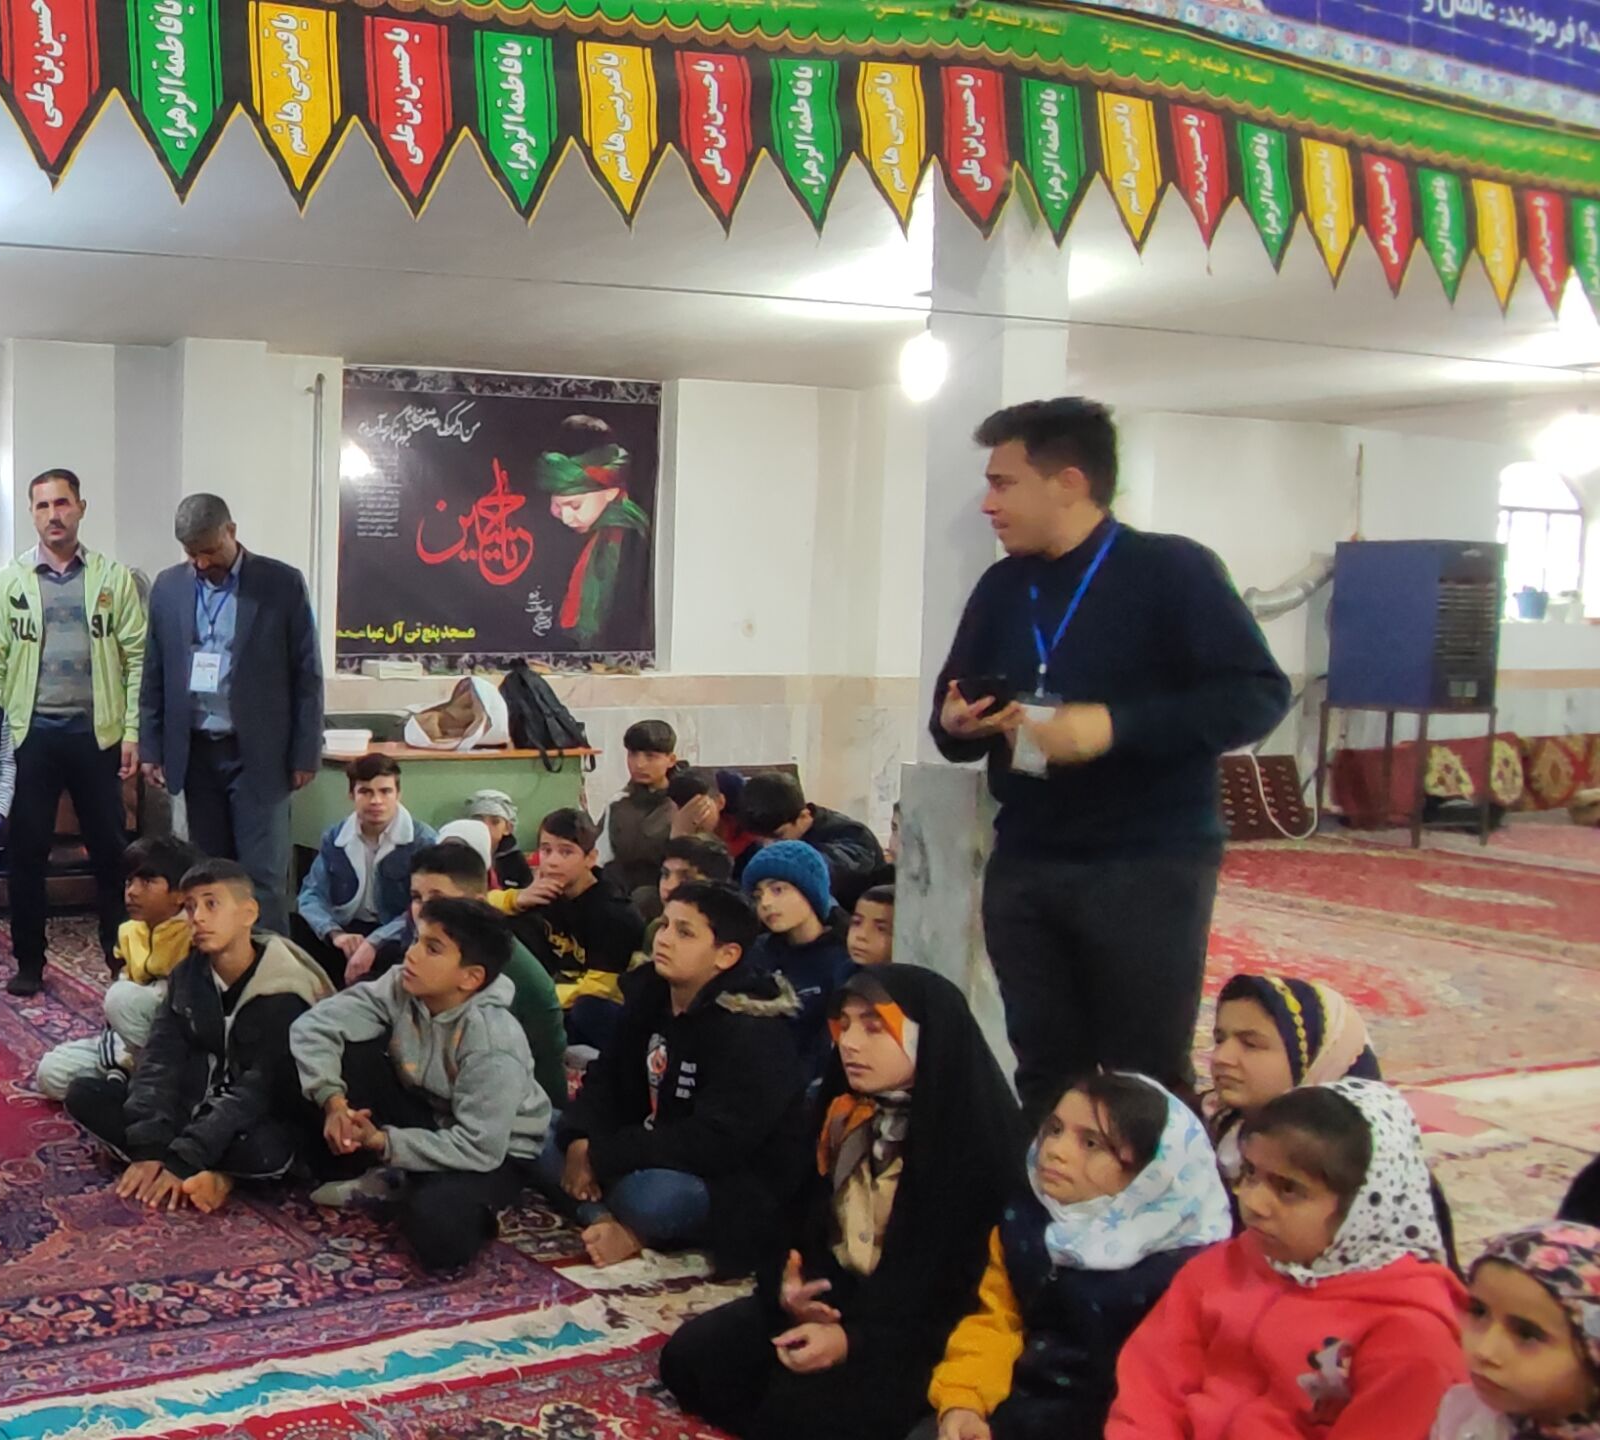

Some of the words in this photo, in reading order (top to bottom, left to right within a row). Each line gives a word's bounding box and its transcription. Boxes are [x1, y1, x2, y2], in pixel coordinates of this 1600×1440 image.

[270, 13, 309, 31] یا
[383, 27, 421, 44] یا
[263, 30, 310, 70] قمر
[497, 41, 533, 57] یا
[595, 52, 628, 66] یا
[33, 54, 67, 85] بن
[392, 43, 424, 100] حسین
[691, 59, 725, 73] یا
[792, 66, 823, 79] یا
[955, 73, 983, 87] یا
[25, 82, 64, 128] علی
[394, 98, 423, 125] بن
[702, 72, 728, 126] حسین
[962, 87, 986, 136] حسین
[272, 101, 311, 157] هاشم
[703, 125, 727, 149] بن
[389, 123, 424, 165] علی
[600, 131, 636, 183] هاشم
[699, 148, 732, 185] علی
[957, 158, 992, 192] علی
[366, 623, 385, 643] عبا
[384, 619, 405, 644] آل
[403, 621, 421, 643] تن
[421, 623, 441, 643] پنج
[440, 624, 476, 643] مسجد
